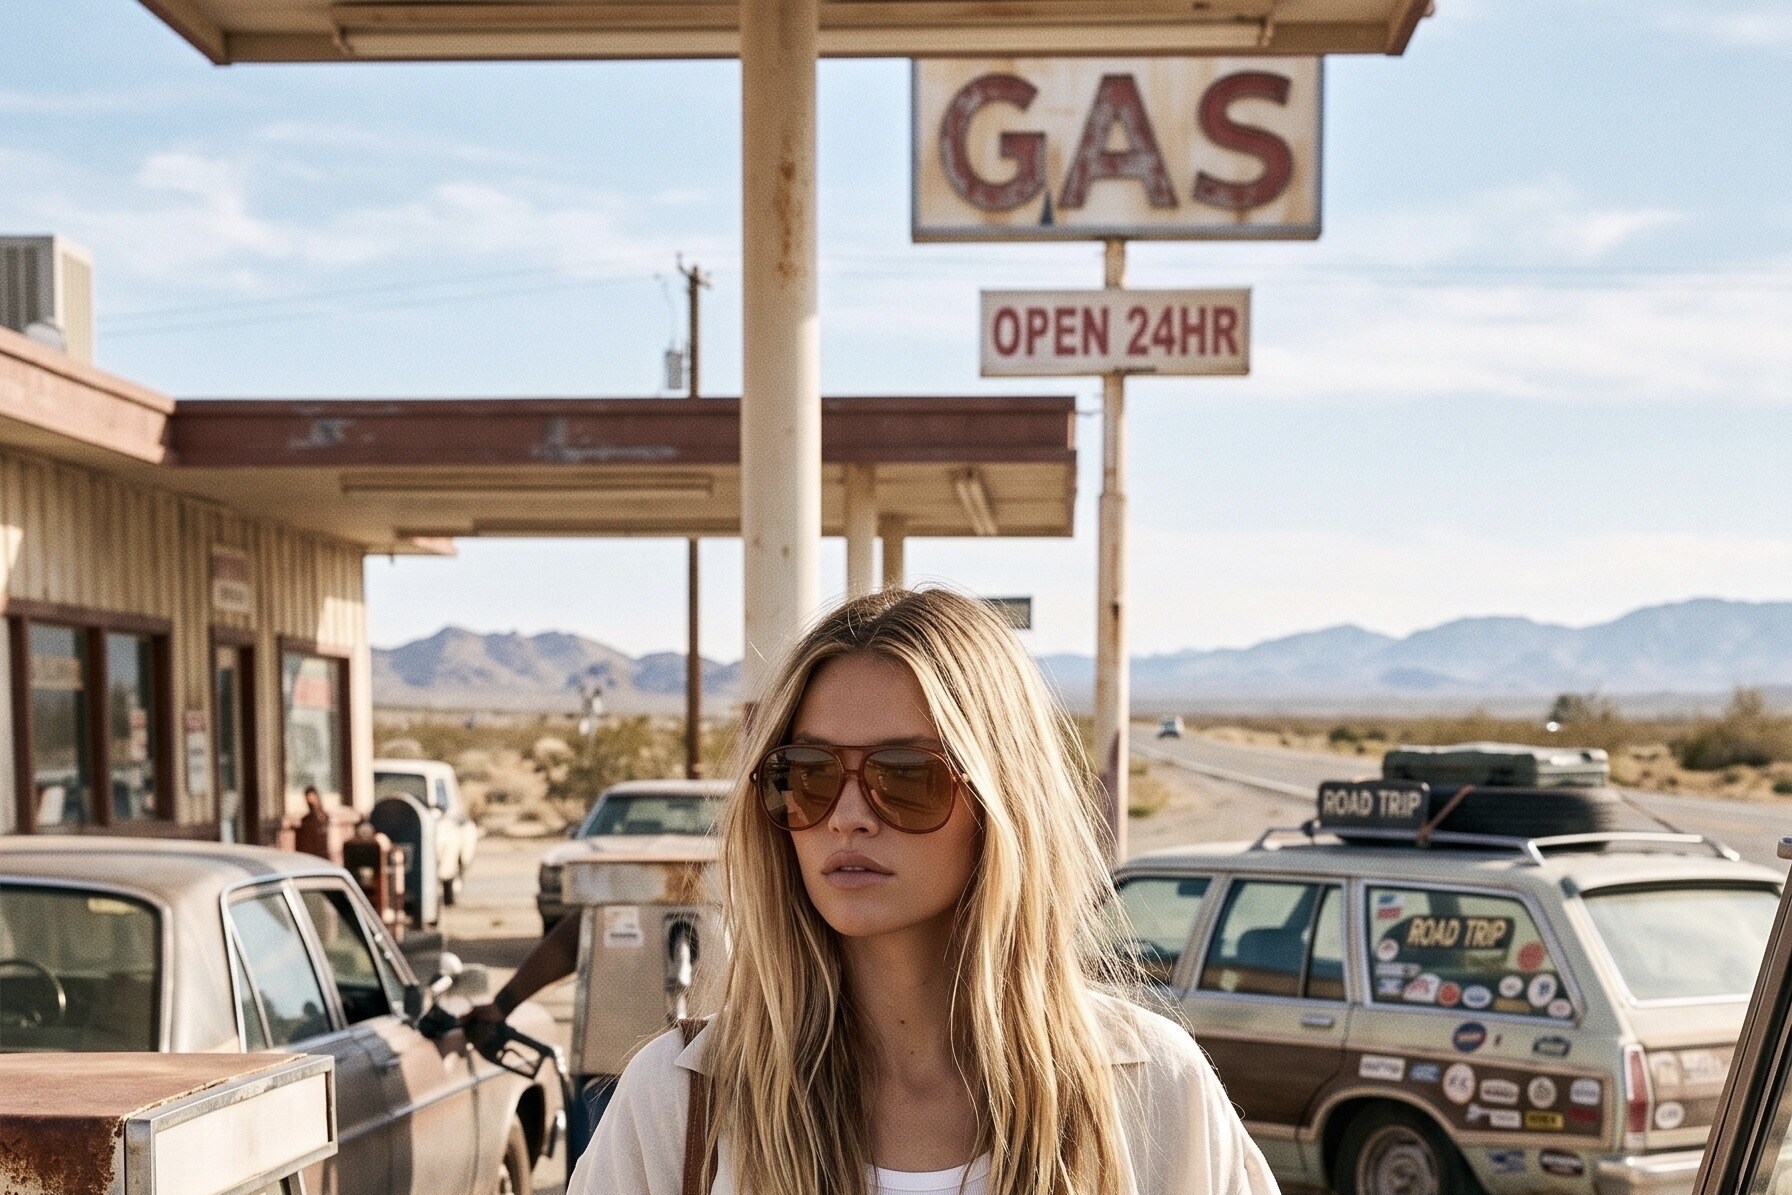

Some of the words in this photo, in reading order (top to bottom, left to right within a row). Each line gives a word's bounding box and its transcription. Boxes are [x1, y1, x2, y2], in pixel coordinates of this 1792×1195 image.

[939, 70, 1295, 213] GAS
[992, 306, 1109, 358] OPEN
[1126, 305, 1239, 358] 24HR
[1323, 789, 1374, 817] ROAD
[1378, 789, 1421, 817] TRIP
[1406, 917, 1461, 948] ROAD
[1463, 917, 1508, 948] TRIP
